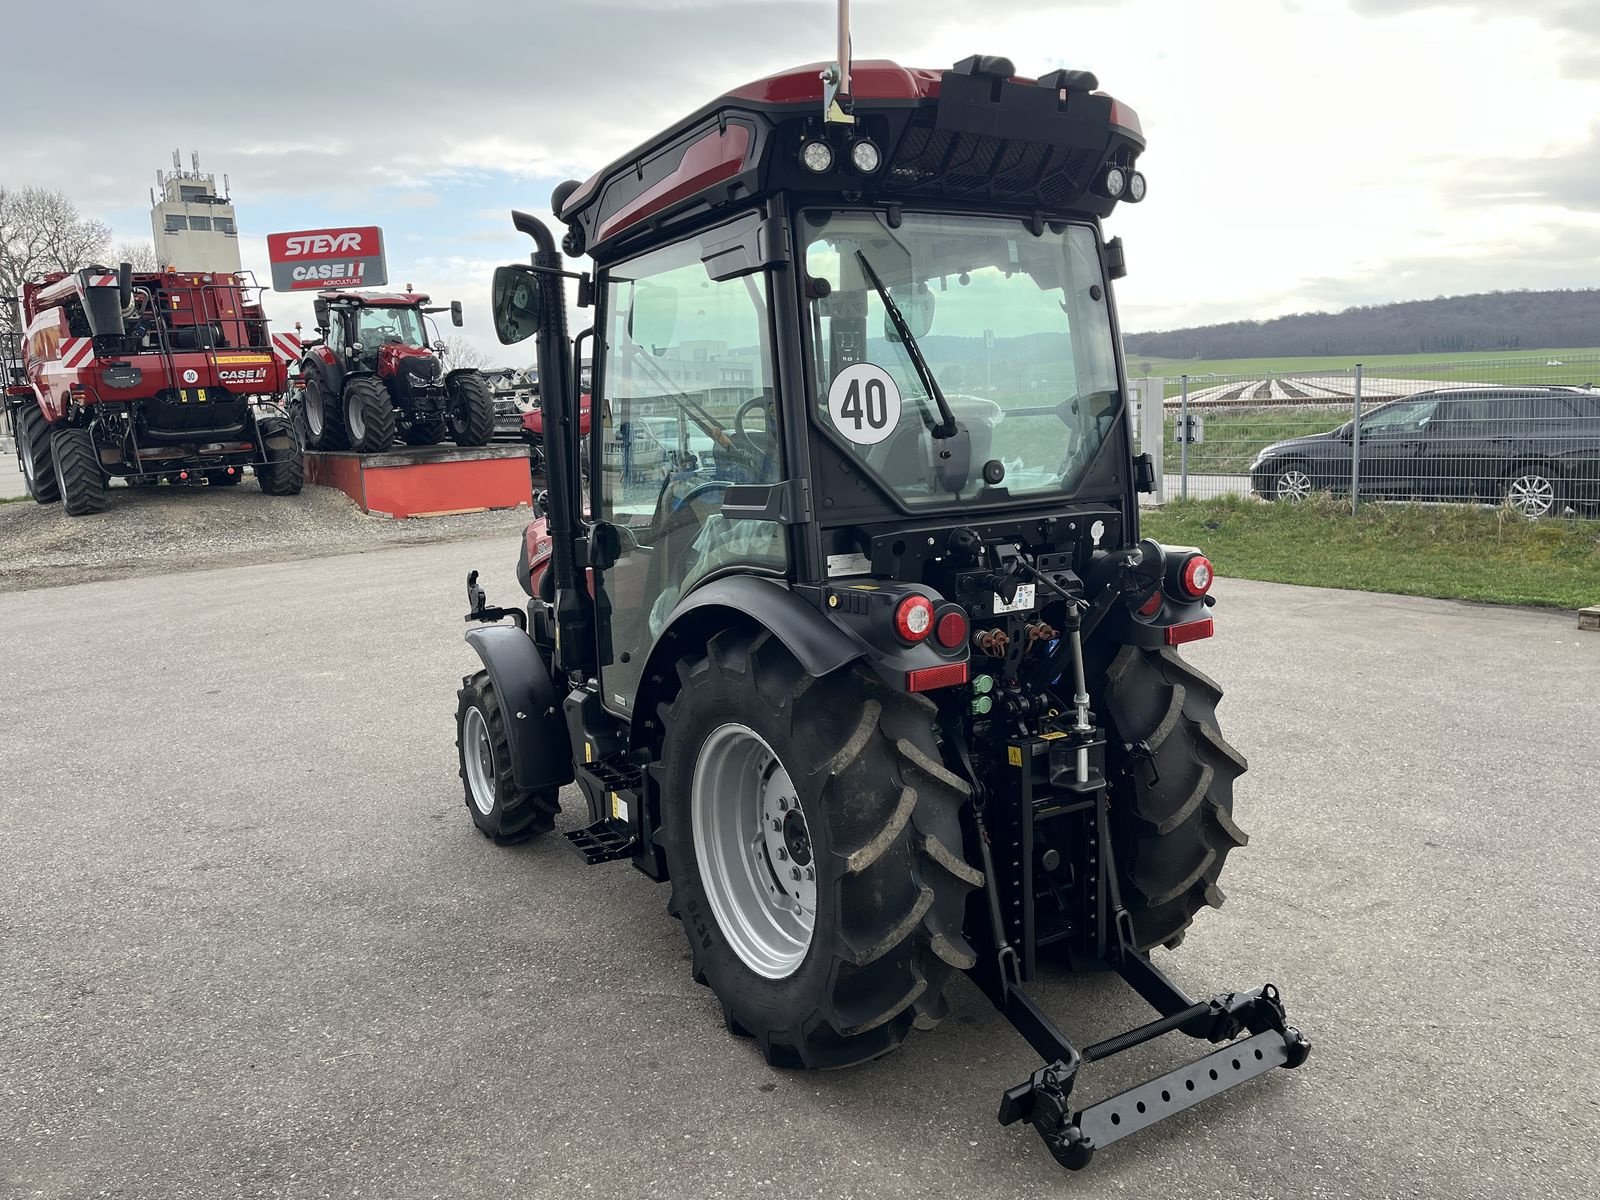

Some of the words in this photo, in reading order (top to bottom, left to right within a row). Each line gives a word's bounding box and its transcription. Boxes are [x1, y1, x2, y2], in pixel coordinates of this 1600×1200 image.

[284, 232, 362, 256] STEYR
[292, 263, 345, 281] CASE
[323, 278, 361, 286] AGRICULTURE
[186, 371, 195, 381] 30
[219, 370, 254, 379] CASE
[840, 378, 888, 430] 40
